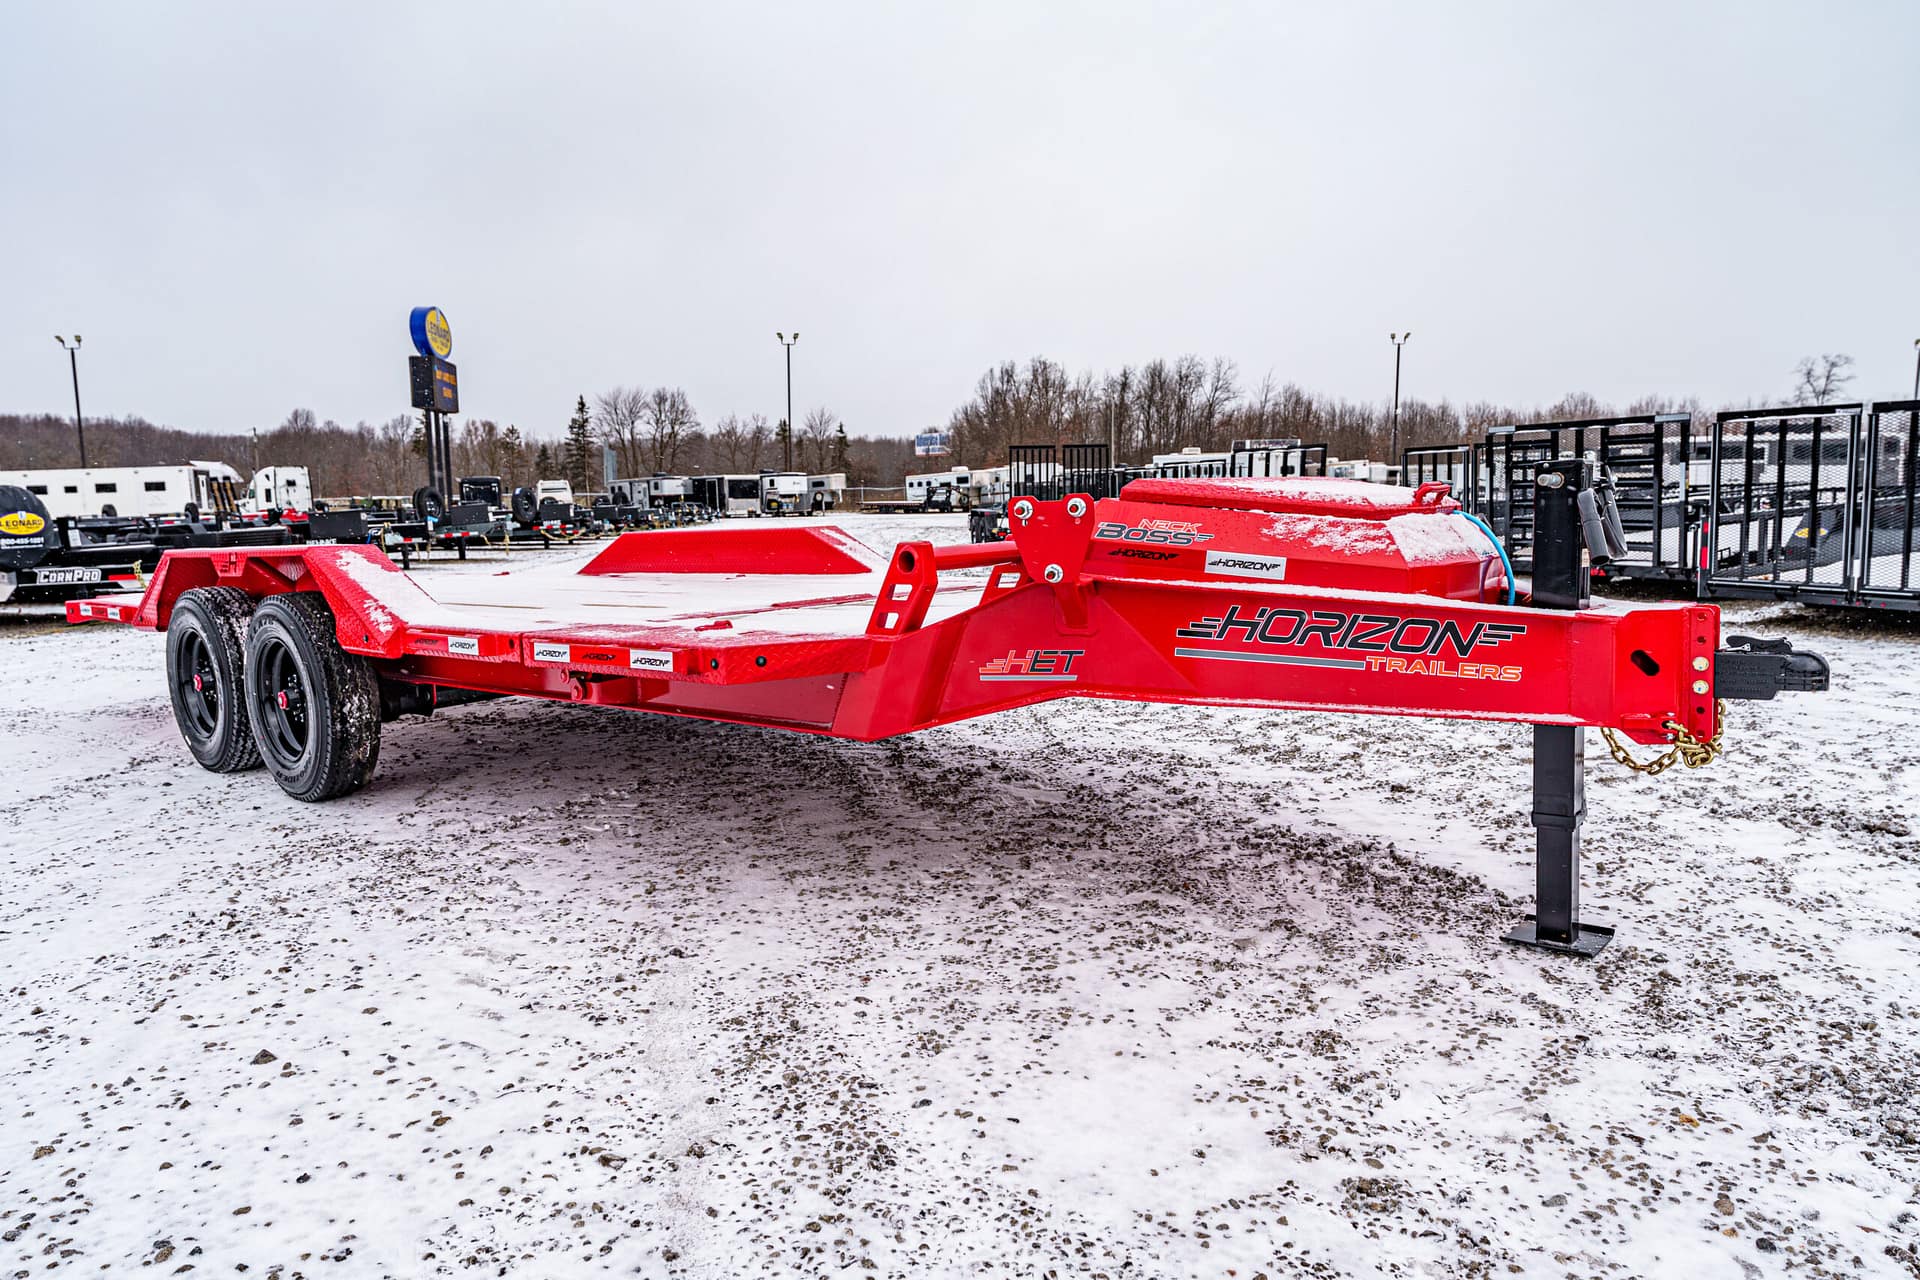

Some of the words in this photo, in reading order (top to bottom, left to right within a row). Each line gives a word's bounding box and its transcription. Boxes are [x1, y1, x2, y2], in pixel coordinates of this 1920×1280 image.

[1139, 519, 1201, 533] NECK
[1094, 522, 1195, 546] BOSS
[1113, 548, 1175, 561] HORIZON
[1213, 558, 1275, 572] HORIZON
[1213, 605, 1487, 658] HORIZON
[537, 649, 565, 658] HORIZON
[634, 656, 668, 667] HORIZON
[998, 649, 1086, 674] HET
[1366, 656, 1523, 682] TRAILERS
